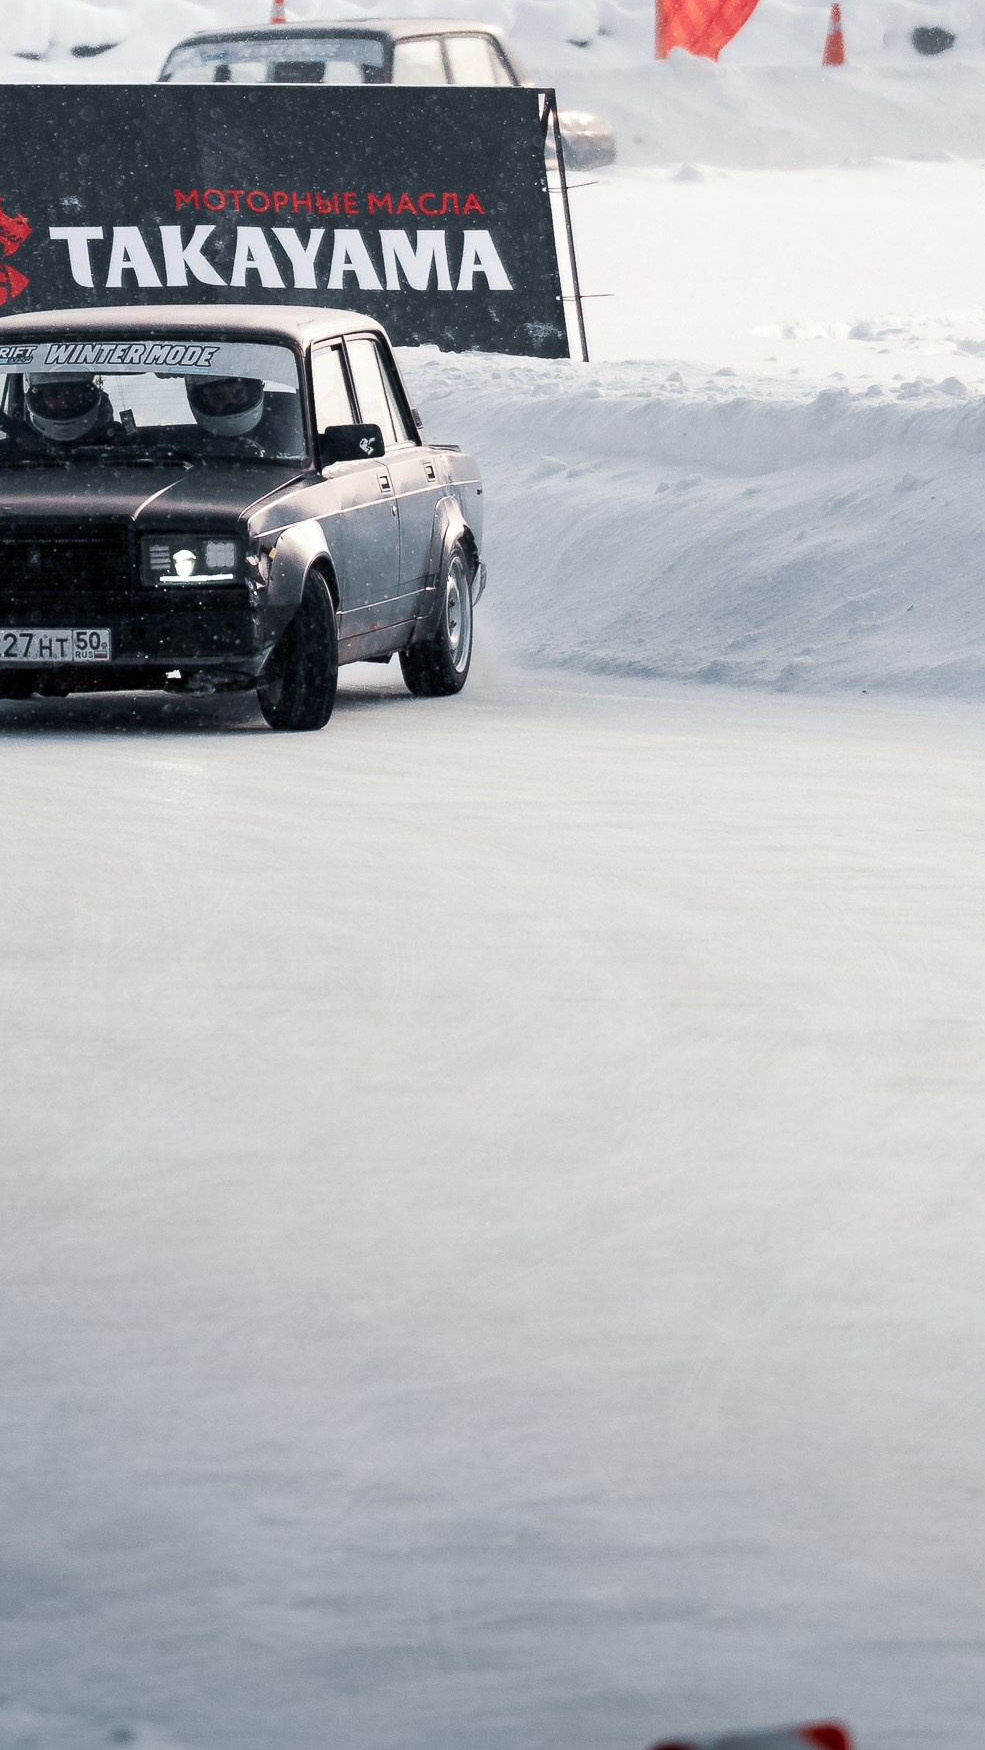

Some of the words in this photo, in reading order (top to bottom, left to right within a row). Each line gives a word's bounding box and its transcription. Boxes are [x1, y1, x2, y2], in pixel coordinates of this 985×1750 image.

[174, 188, 359, 214] МОТОРНЫЕ
[368, 192, 485, 216] МАСЛА
[48, 224, 514, 291] TAKAYAMA
[44, 344, 146, 364] WINTER
[144, 344, 220, 366] MODE
[76, 632, 101, 649] 50
